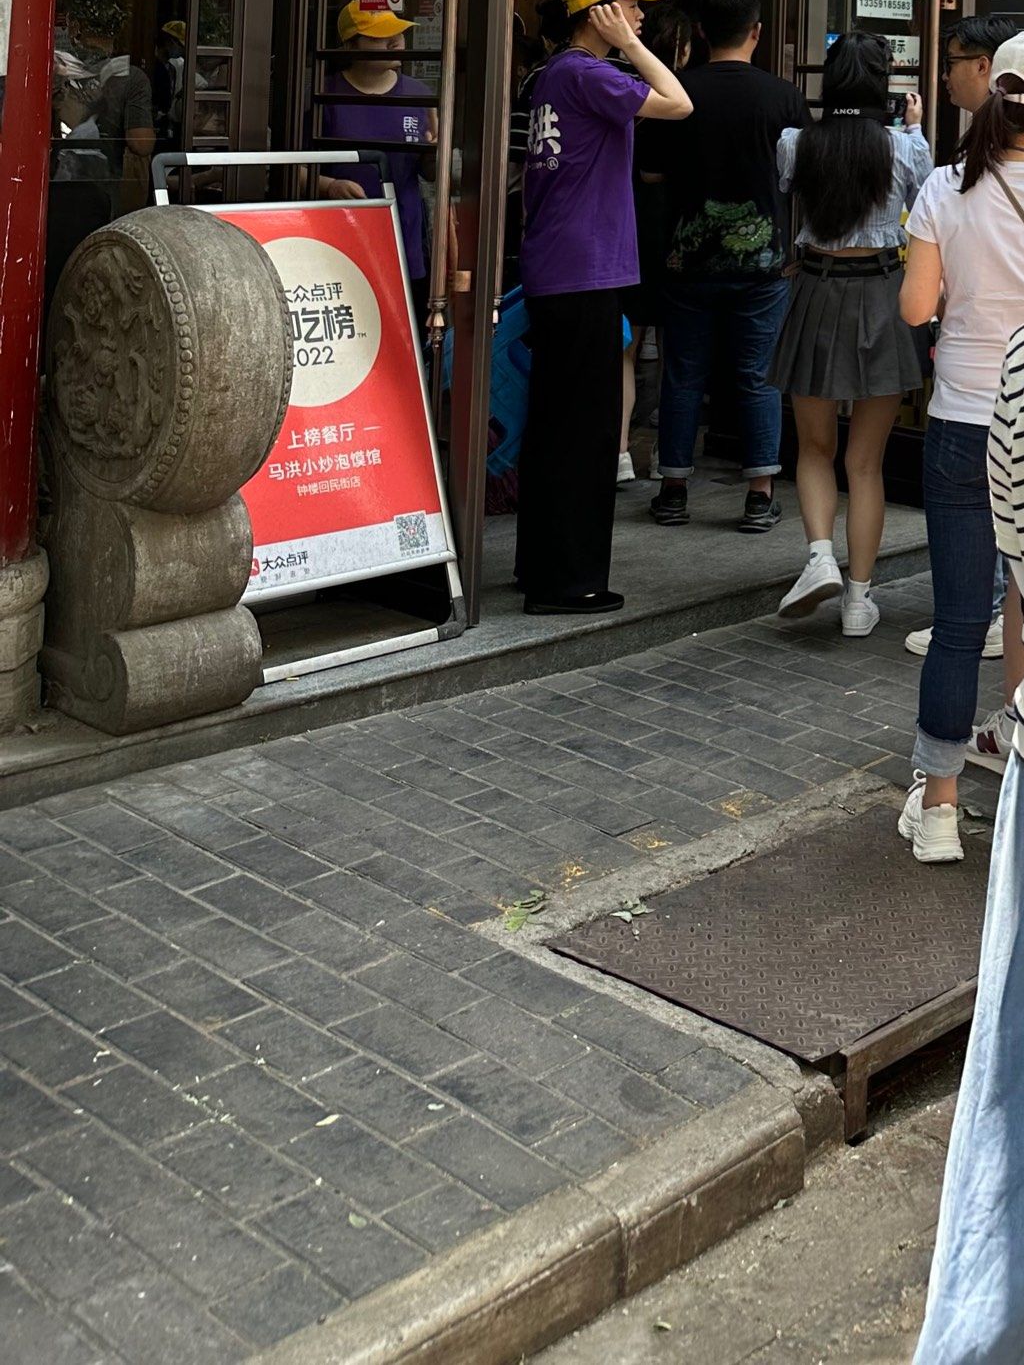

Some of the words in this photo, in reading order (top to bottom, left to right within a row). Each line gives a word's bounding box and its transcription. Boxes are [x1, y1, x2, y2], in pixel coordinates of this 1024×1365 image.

[293, 346, 335, 367] 022
[287, 423, 356, 450] 上榜餐厅
[268, 448, 382, 481] 马洪小炒泡馍馆
[296, 475, 361, 497] 钟楼回民街店
[261, 551, 309, 572] 大众点评
